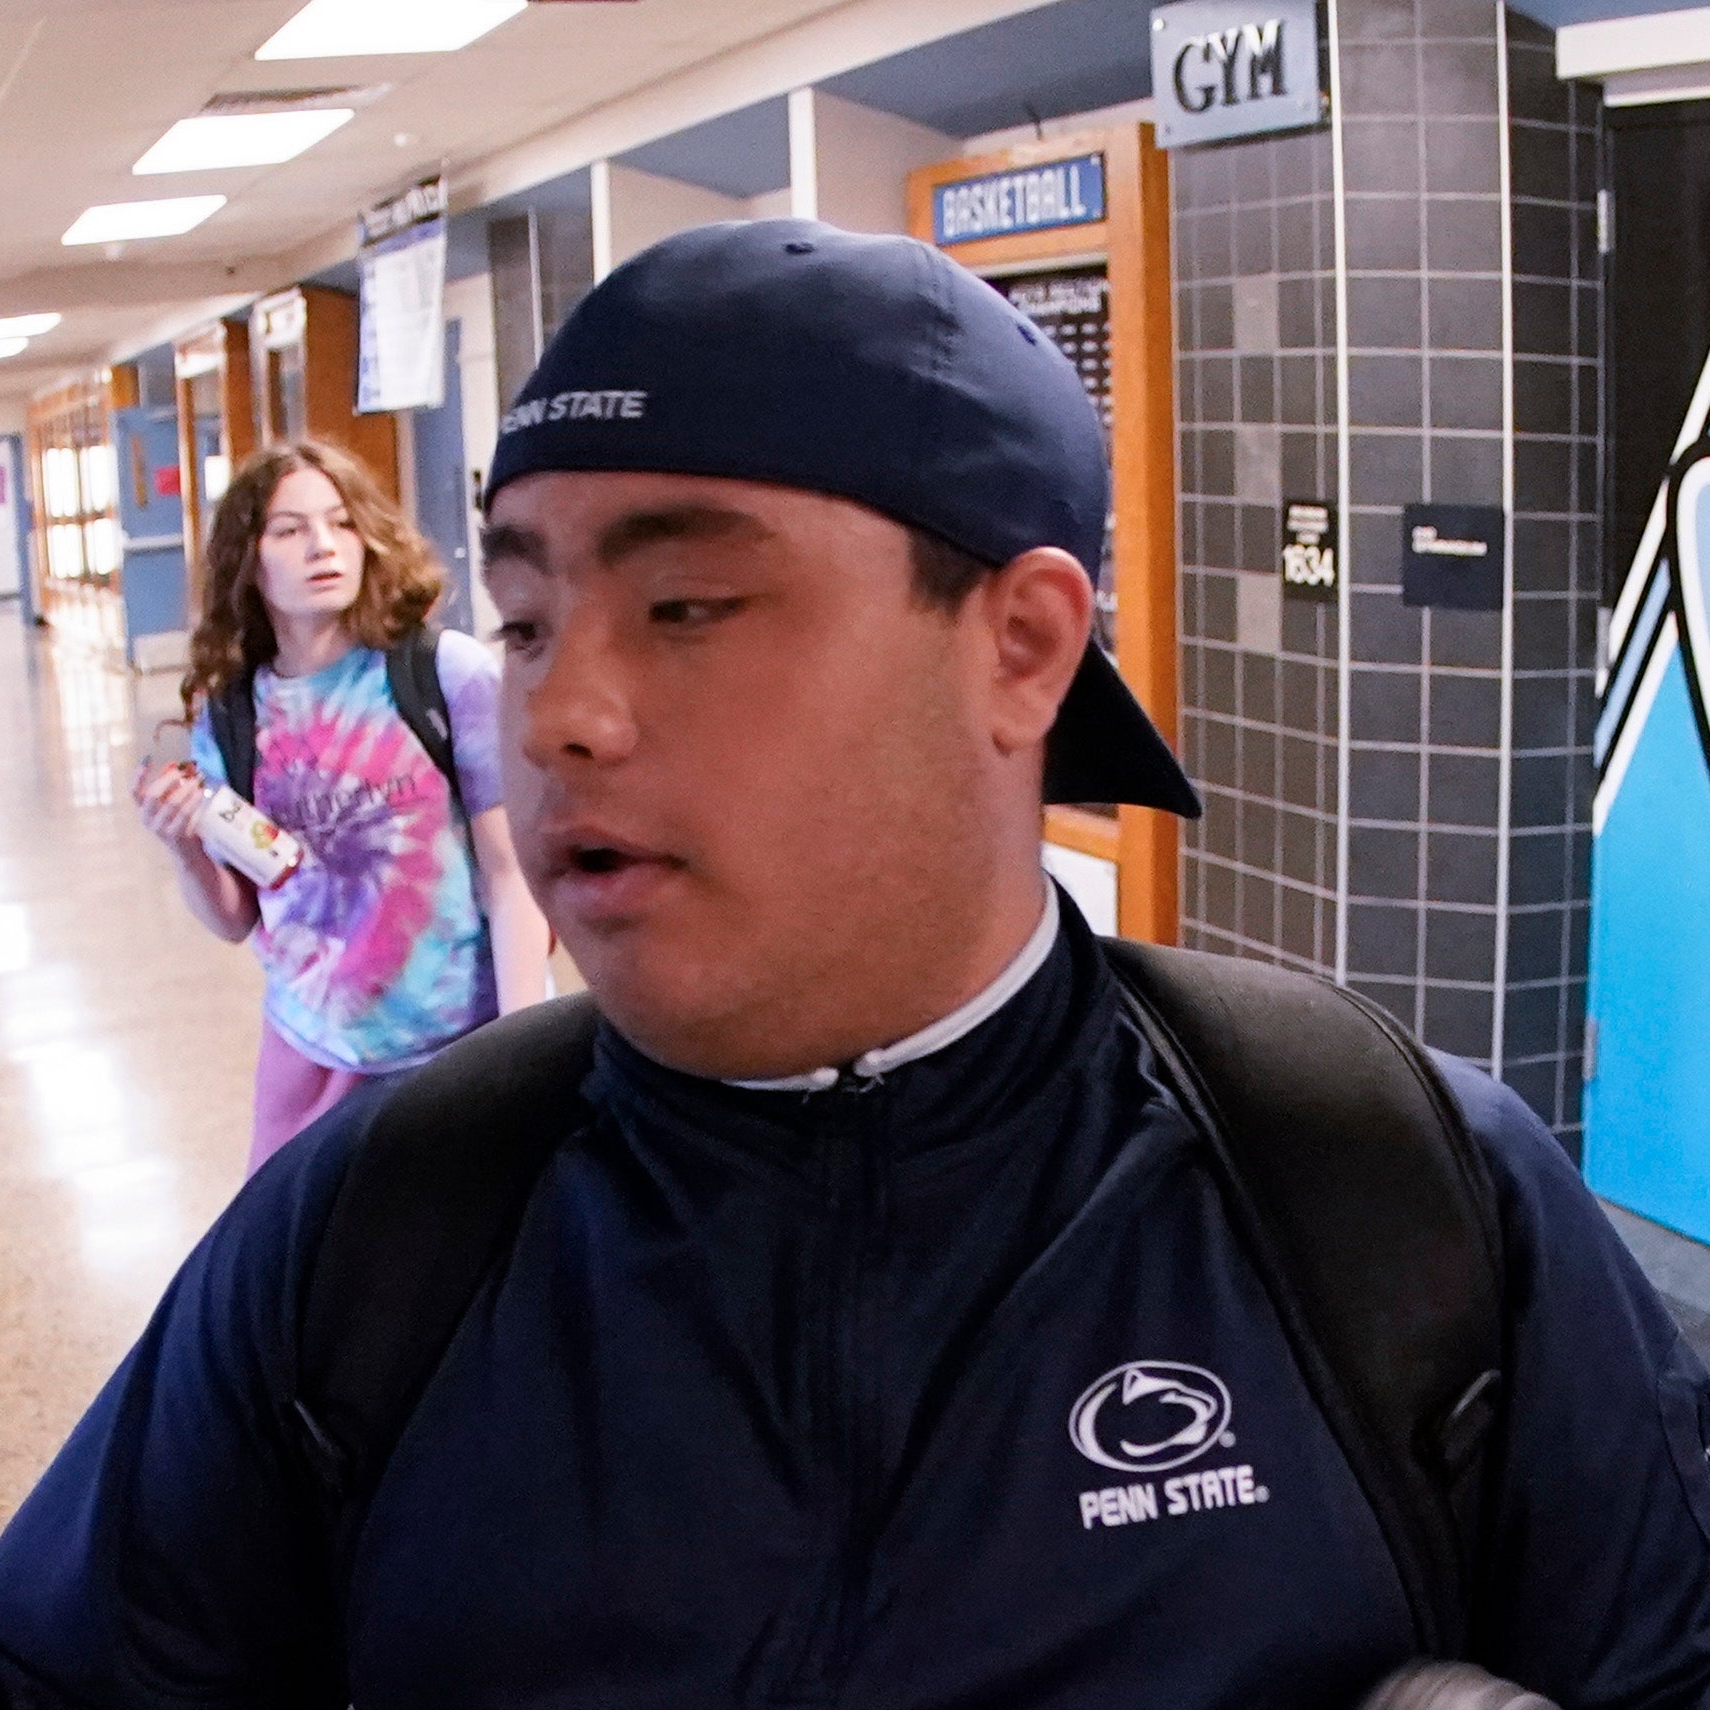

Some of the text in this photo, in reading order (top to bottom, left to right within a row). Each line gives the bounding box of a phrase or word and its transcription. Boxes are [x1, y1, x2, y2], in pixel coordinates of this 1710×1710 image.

[1172, 18, 1289, 115] GYM
[942, 164, 1088, 238] BASKETBALL
[547, 389, 648, 421] STATE
[1078, 1483, 1159, 1530] PENN
